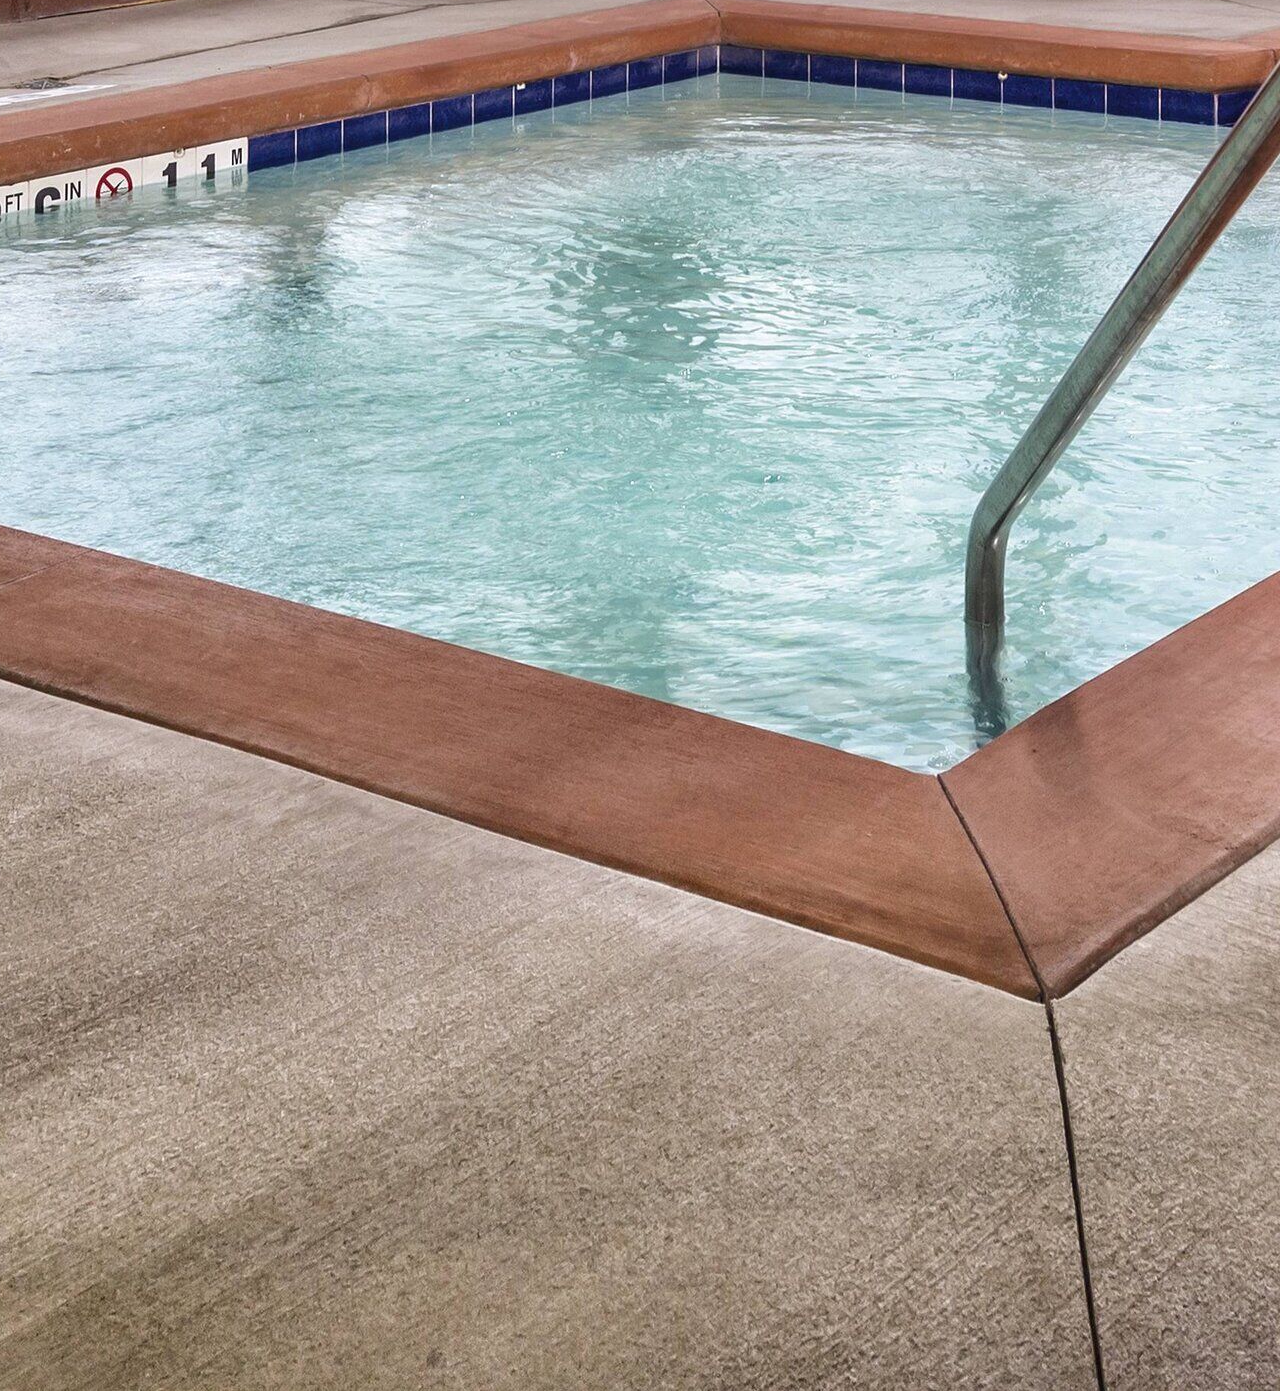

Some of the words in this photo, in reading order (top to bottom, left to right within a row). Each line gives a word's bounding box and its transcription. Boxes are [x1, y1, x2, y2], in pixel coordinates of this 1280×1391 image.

[5, 192, 24, 214] FT
[64, 180, 82, 202] IN
[231, 147, 243, 167] M
